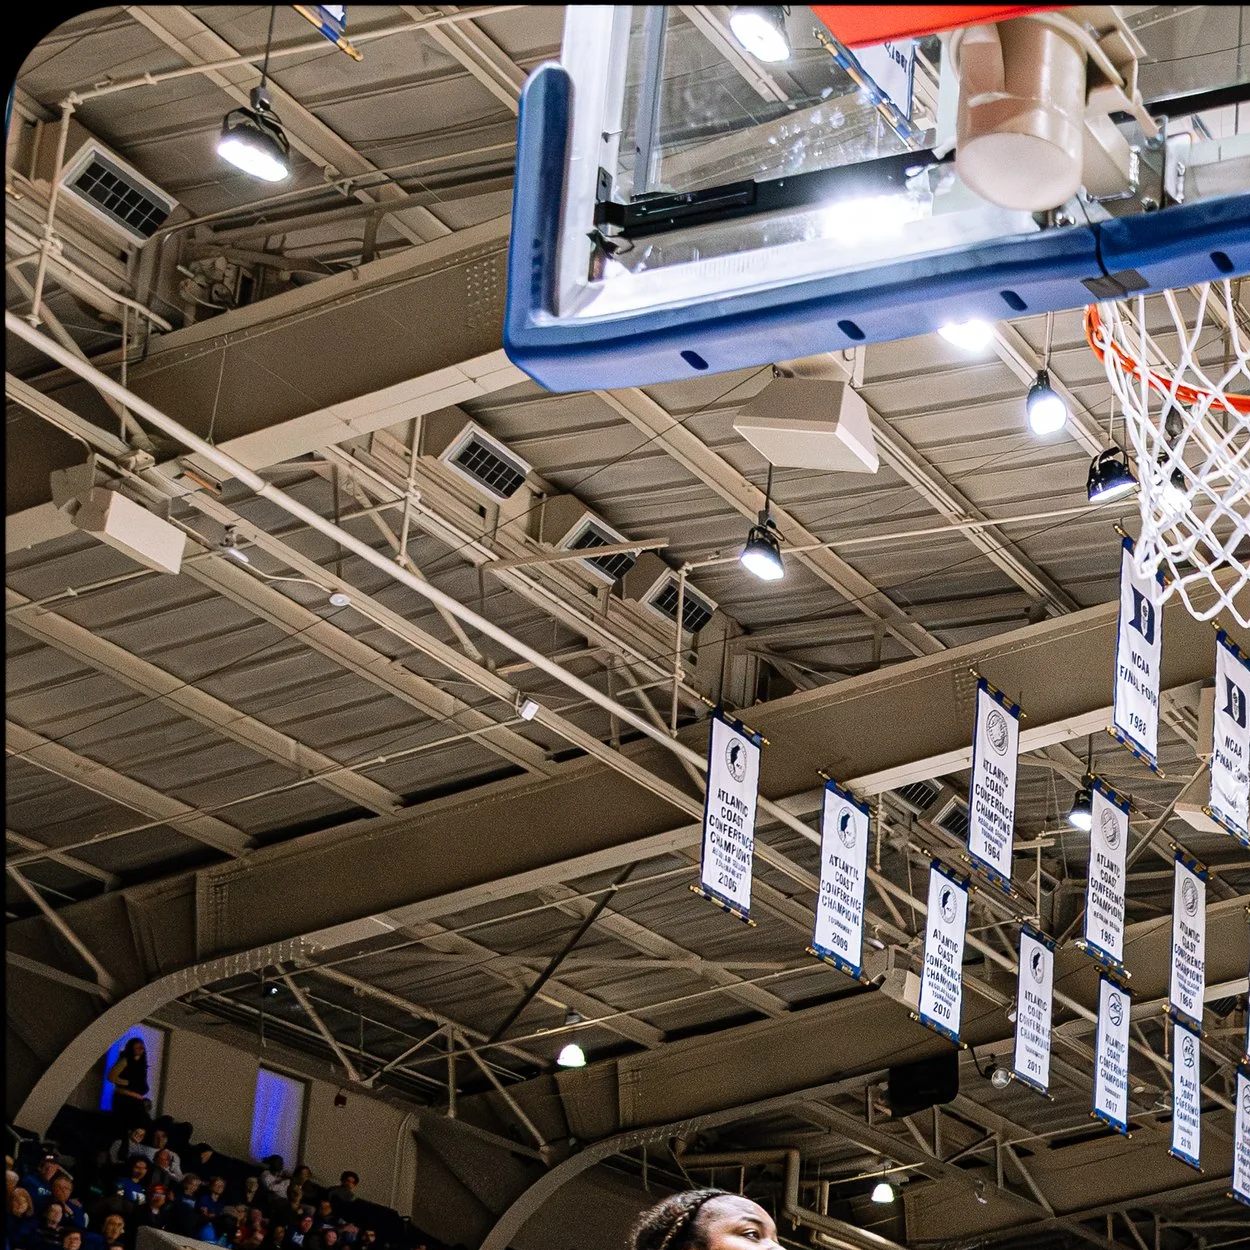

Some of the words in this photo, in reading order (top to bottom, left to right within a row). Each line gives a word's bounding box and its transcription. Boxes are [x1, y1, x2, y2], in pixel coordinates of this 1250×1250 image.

[1132, 651, 1150, 676] NCAA
[1225, 736, 1242, 758] NCAA
[717, 788, 749, 817] ATLANTIC
[721, 806, 743, 829] COAST
[709, 814, 753, 851] CONFERENCE
[710, 831, 750, 865] CHAMPIONS
[984, 841, 1000, 861] 1964
[829, 854, 859, 880] ATLANTIC
[835, 871, 854, 893] COAST
[821, 879, 861, 913] CONFERENCE
[821, 895, 859, 926] CHAMPIONS
[832, 932, 848, 951] 2009
[933, 1002, 950, 1020] 2010
